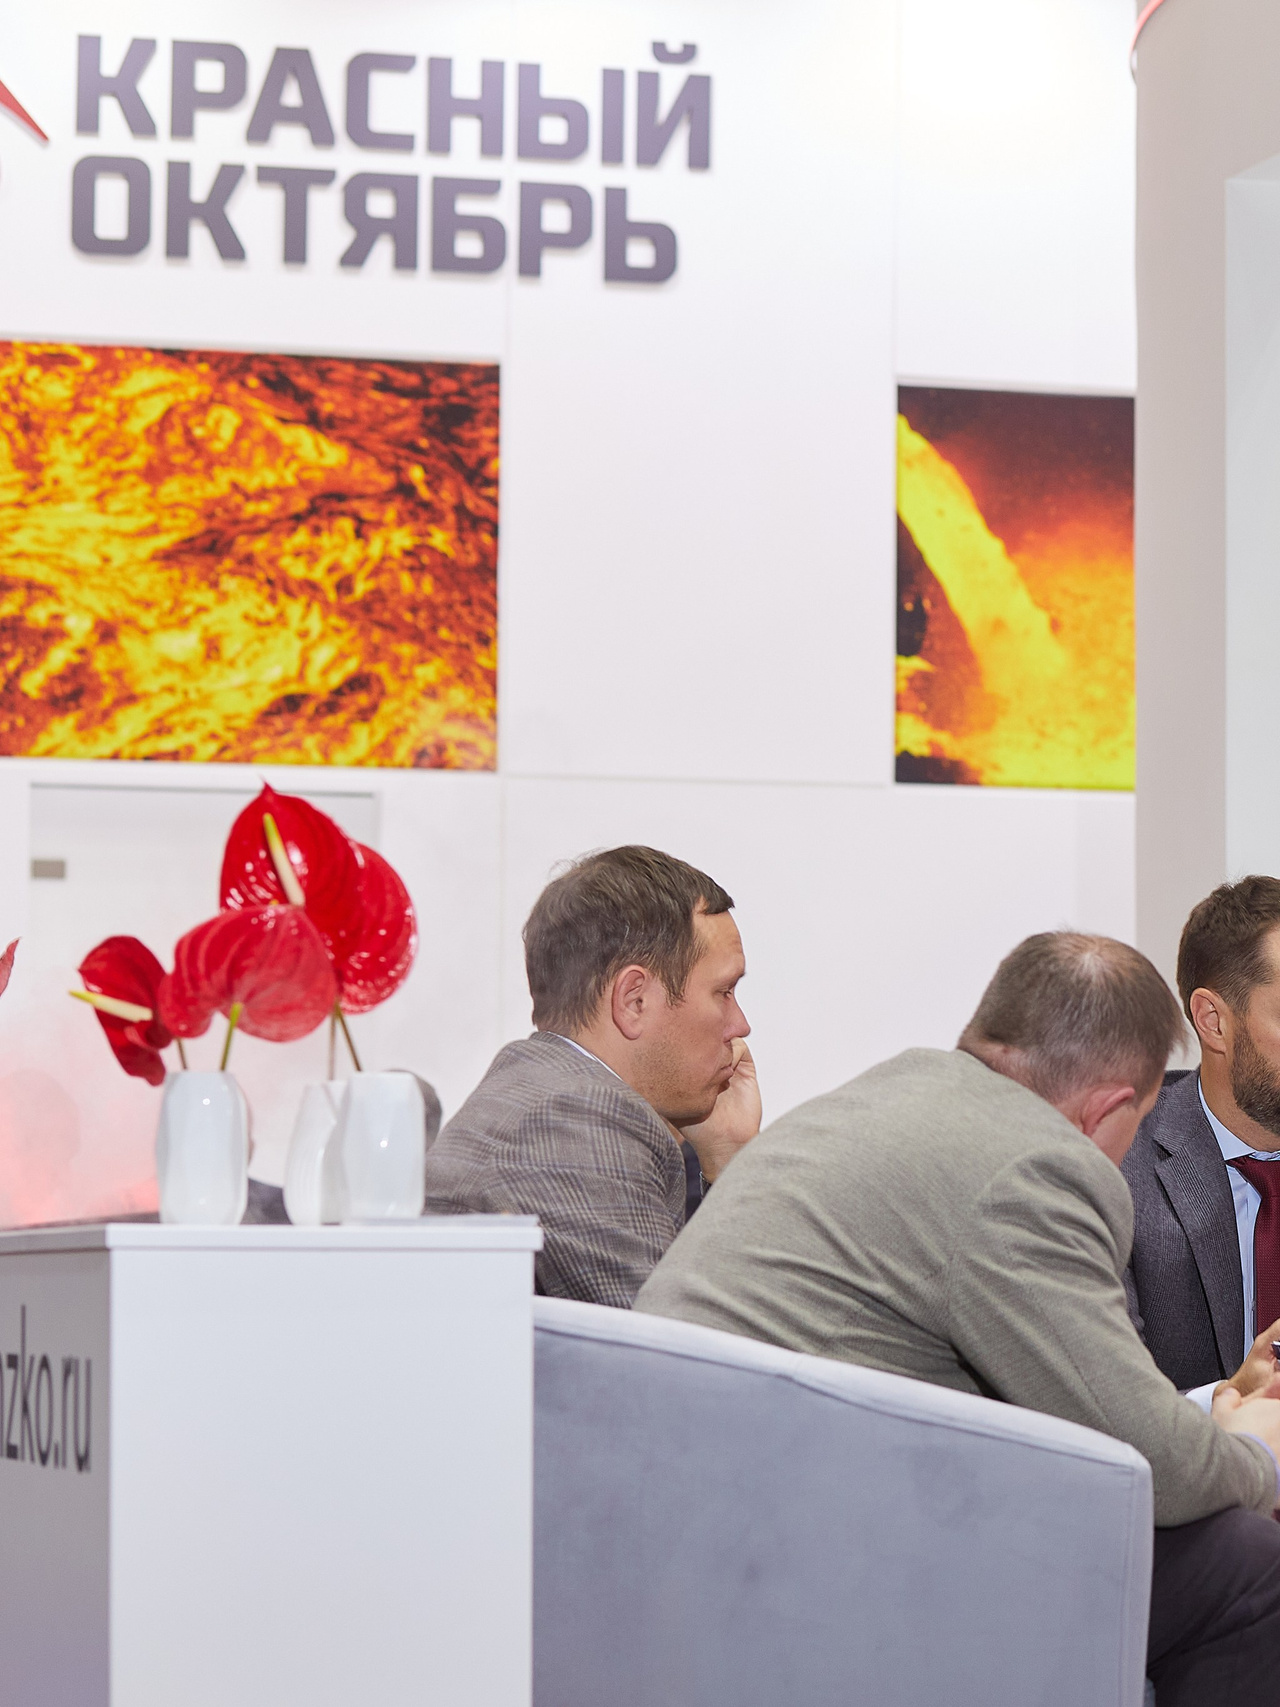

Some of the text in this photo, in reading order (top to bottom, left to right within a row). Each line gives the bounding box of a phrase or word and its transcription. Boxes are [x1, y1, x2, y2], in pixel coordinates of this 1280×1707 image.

[75, 34, 712, 171] КРАСНЫЙ
[71, 155, 678, 284] ОКТЯБРЬ
[0, 1304, 92, 1474] zko.ru
